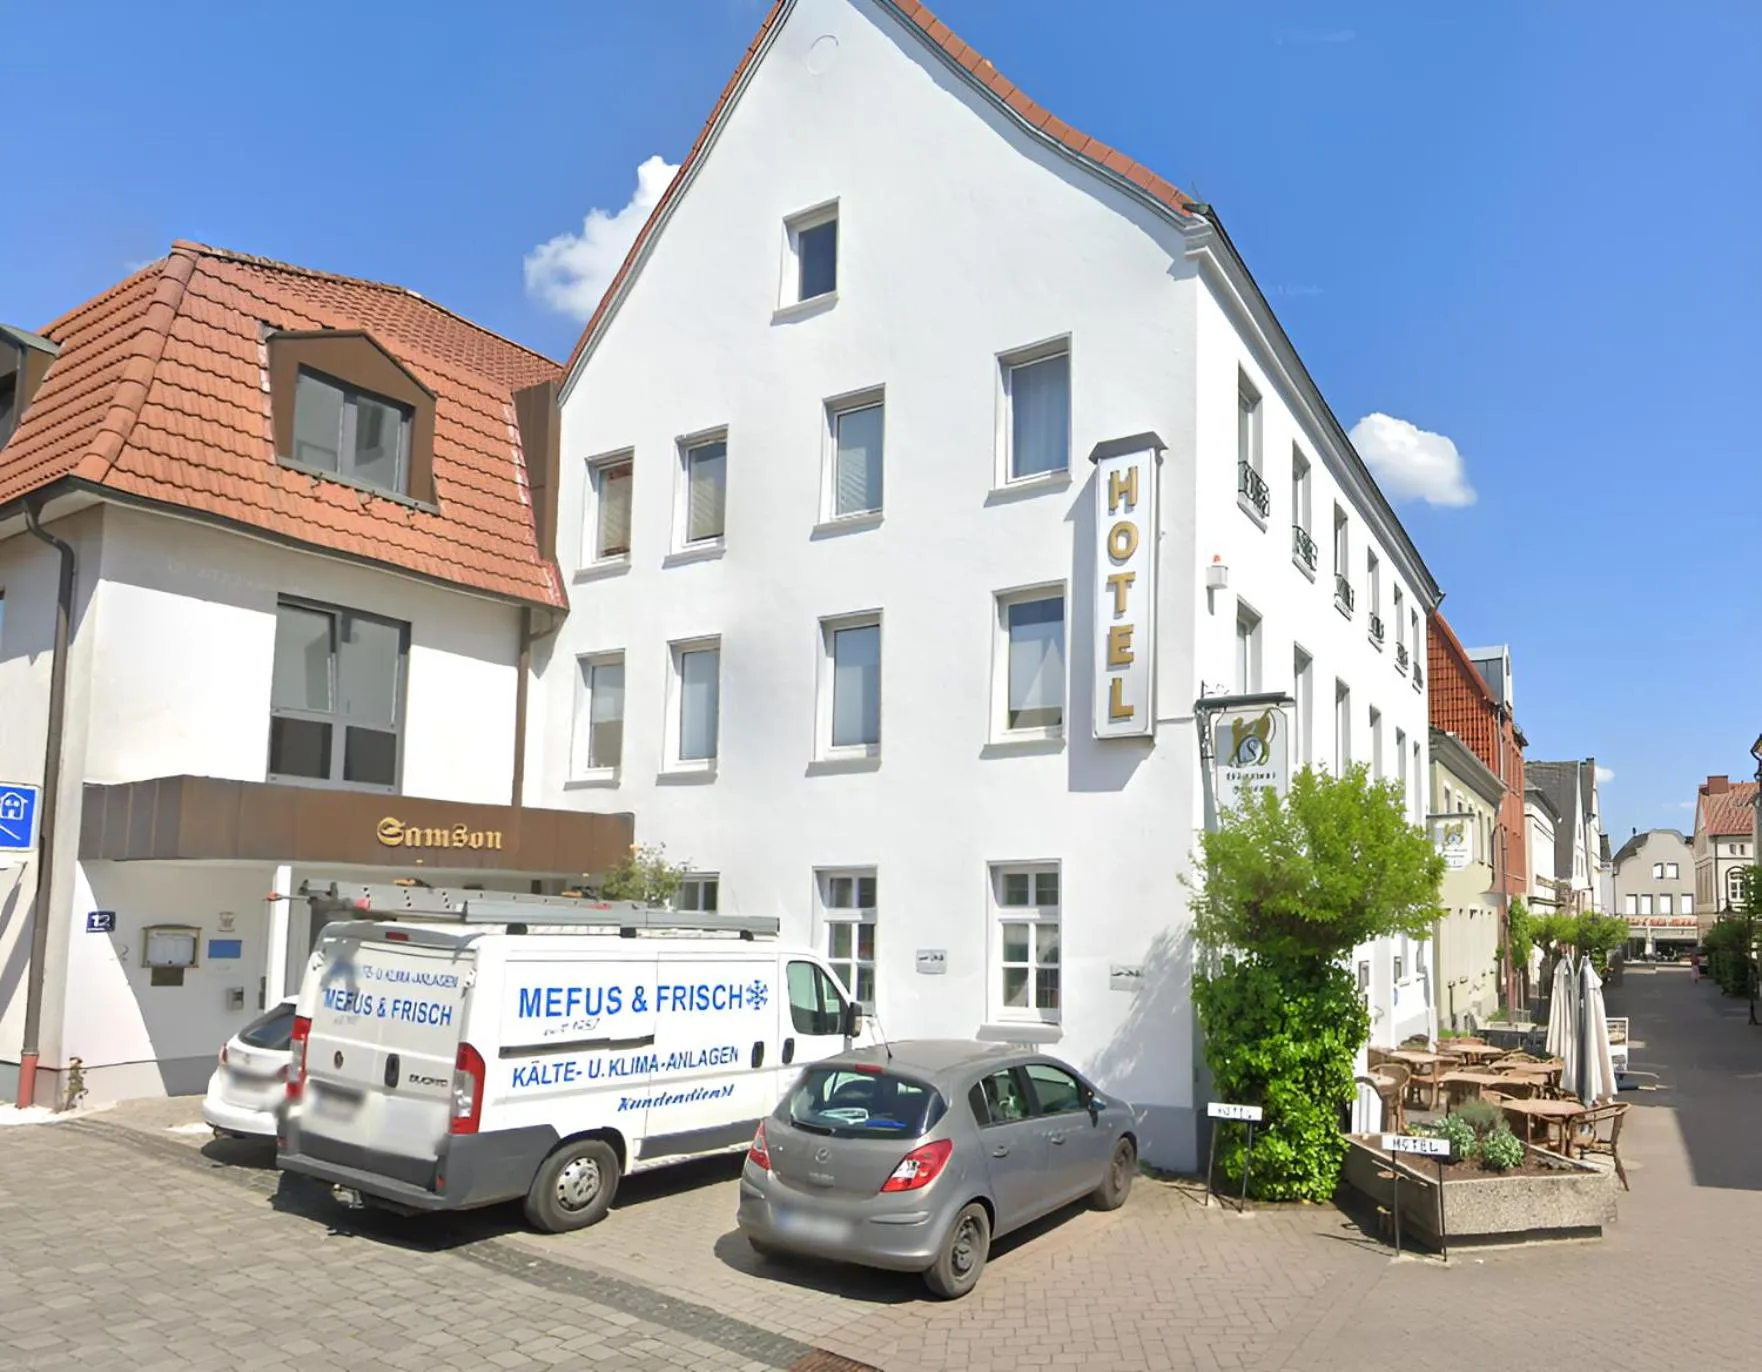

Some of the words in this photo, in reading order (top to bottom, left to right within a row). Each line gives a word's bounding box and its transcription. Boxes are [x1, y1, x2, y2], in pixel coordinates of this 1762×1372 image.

[1107, 465, 1139, 718] HOTEL
[377, 816, 503, 850] Samson
[91, 914, 111, 928] 12
[322, 987, 373, 1015] MEFUS
[376, 997, 386, 1018] &
[391, 999, 453, 1026] FRISCH
[517, 986, 623, 1018] MEFUS
[631, 985, 648, 1013] &
[656, 983, 743, 1013] FRISCH
[512, 1060, 583, 1088] KÄLTE-
